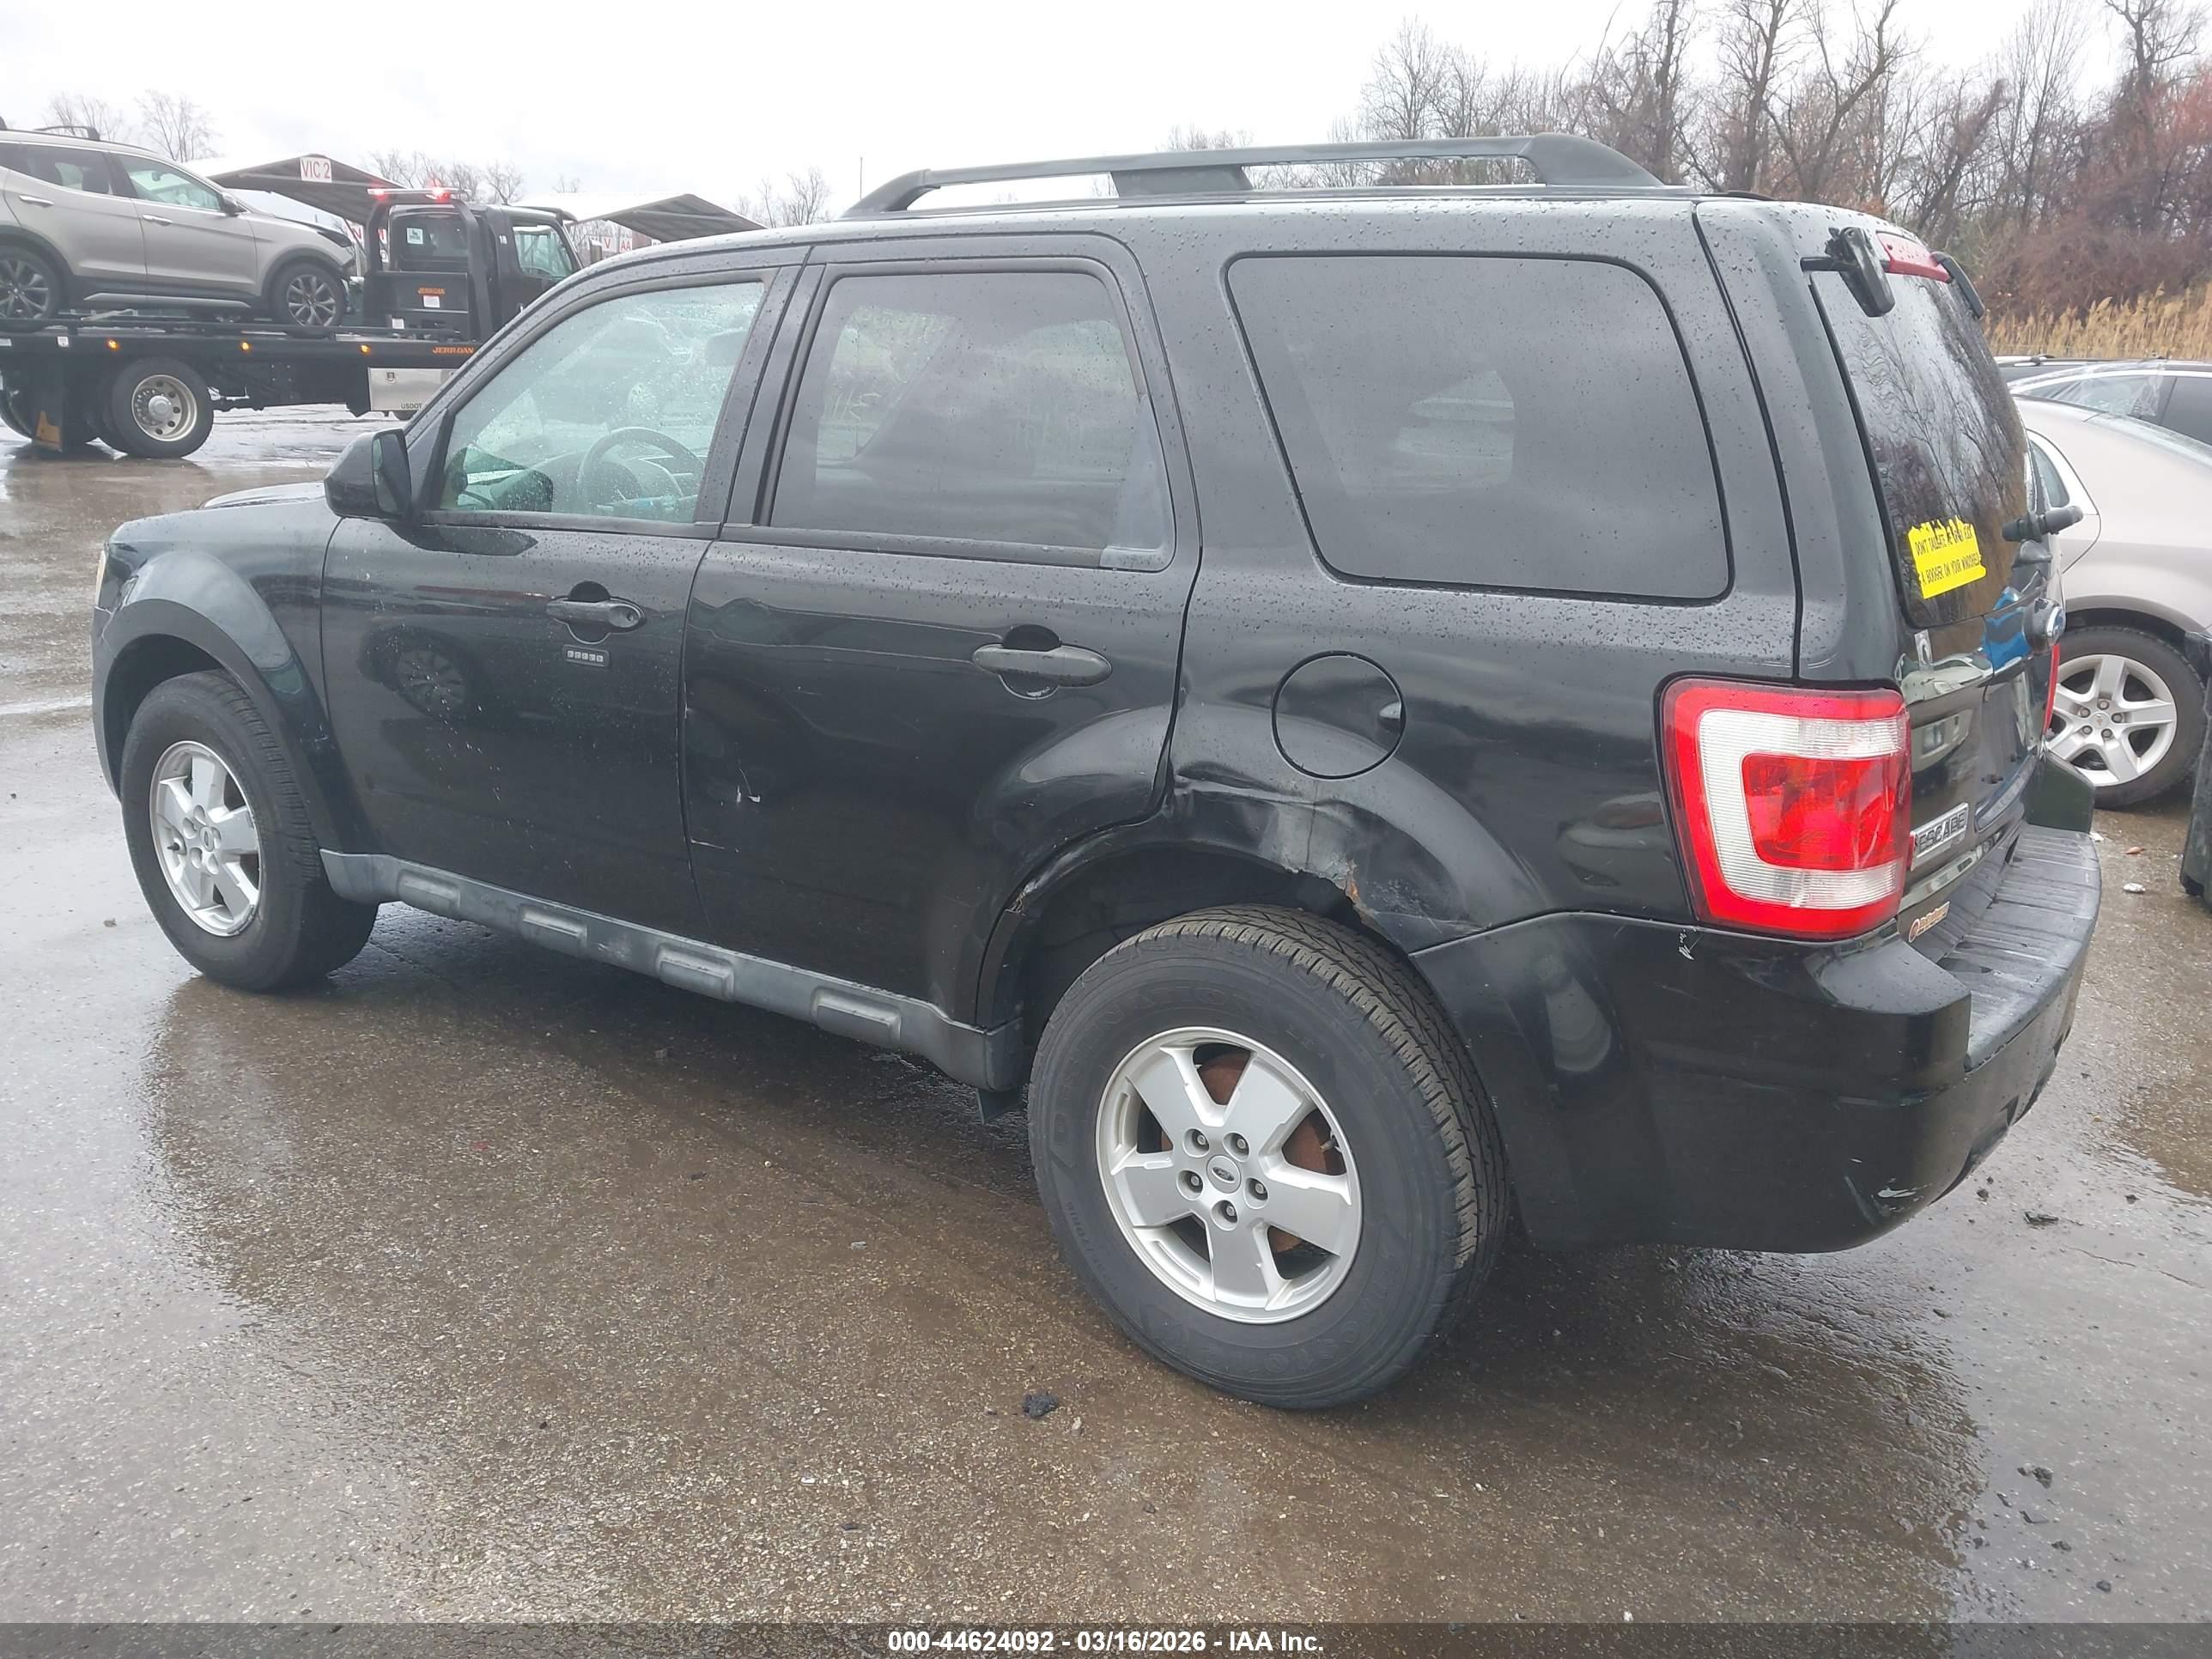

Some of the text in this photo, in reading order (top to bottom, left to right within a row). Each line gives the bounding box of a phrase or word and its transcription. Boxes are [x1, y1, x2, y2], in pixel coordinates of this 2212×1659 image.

[301, 159, 331, 179] VIC 2
[1917, 809, 1966, 853] ESCAPE
